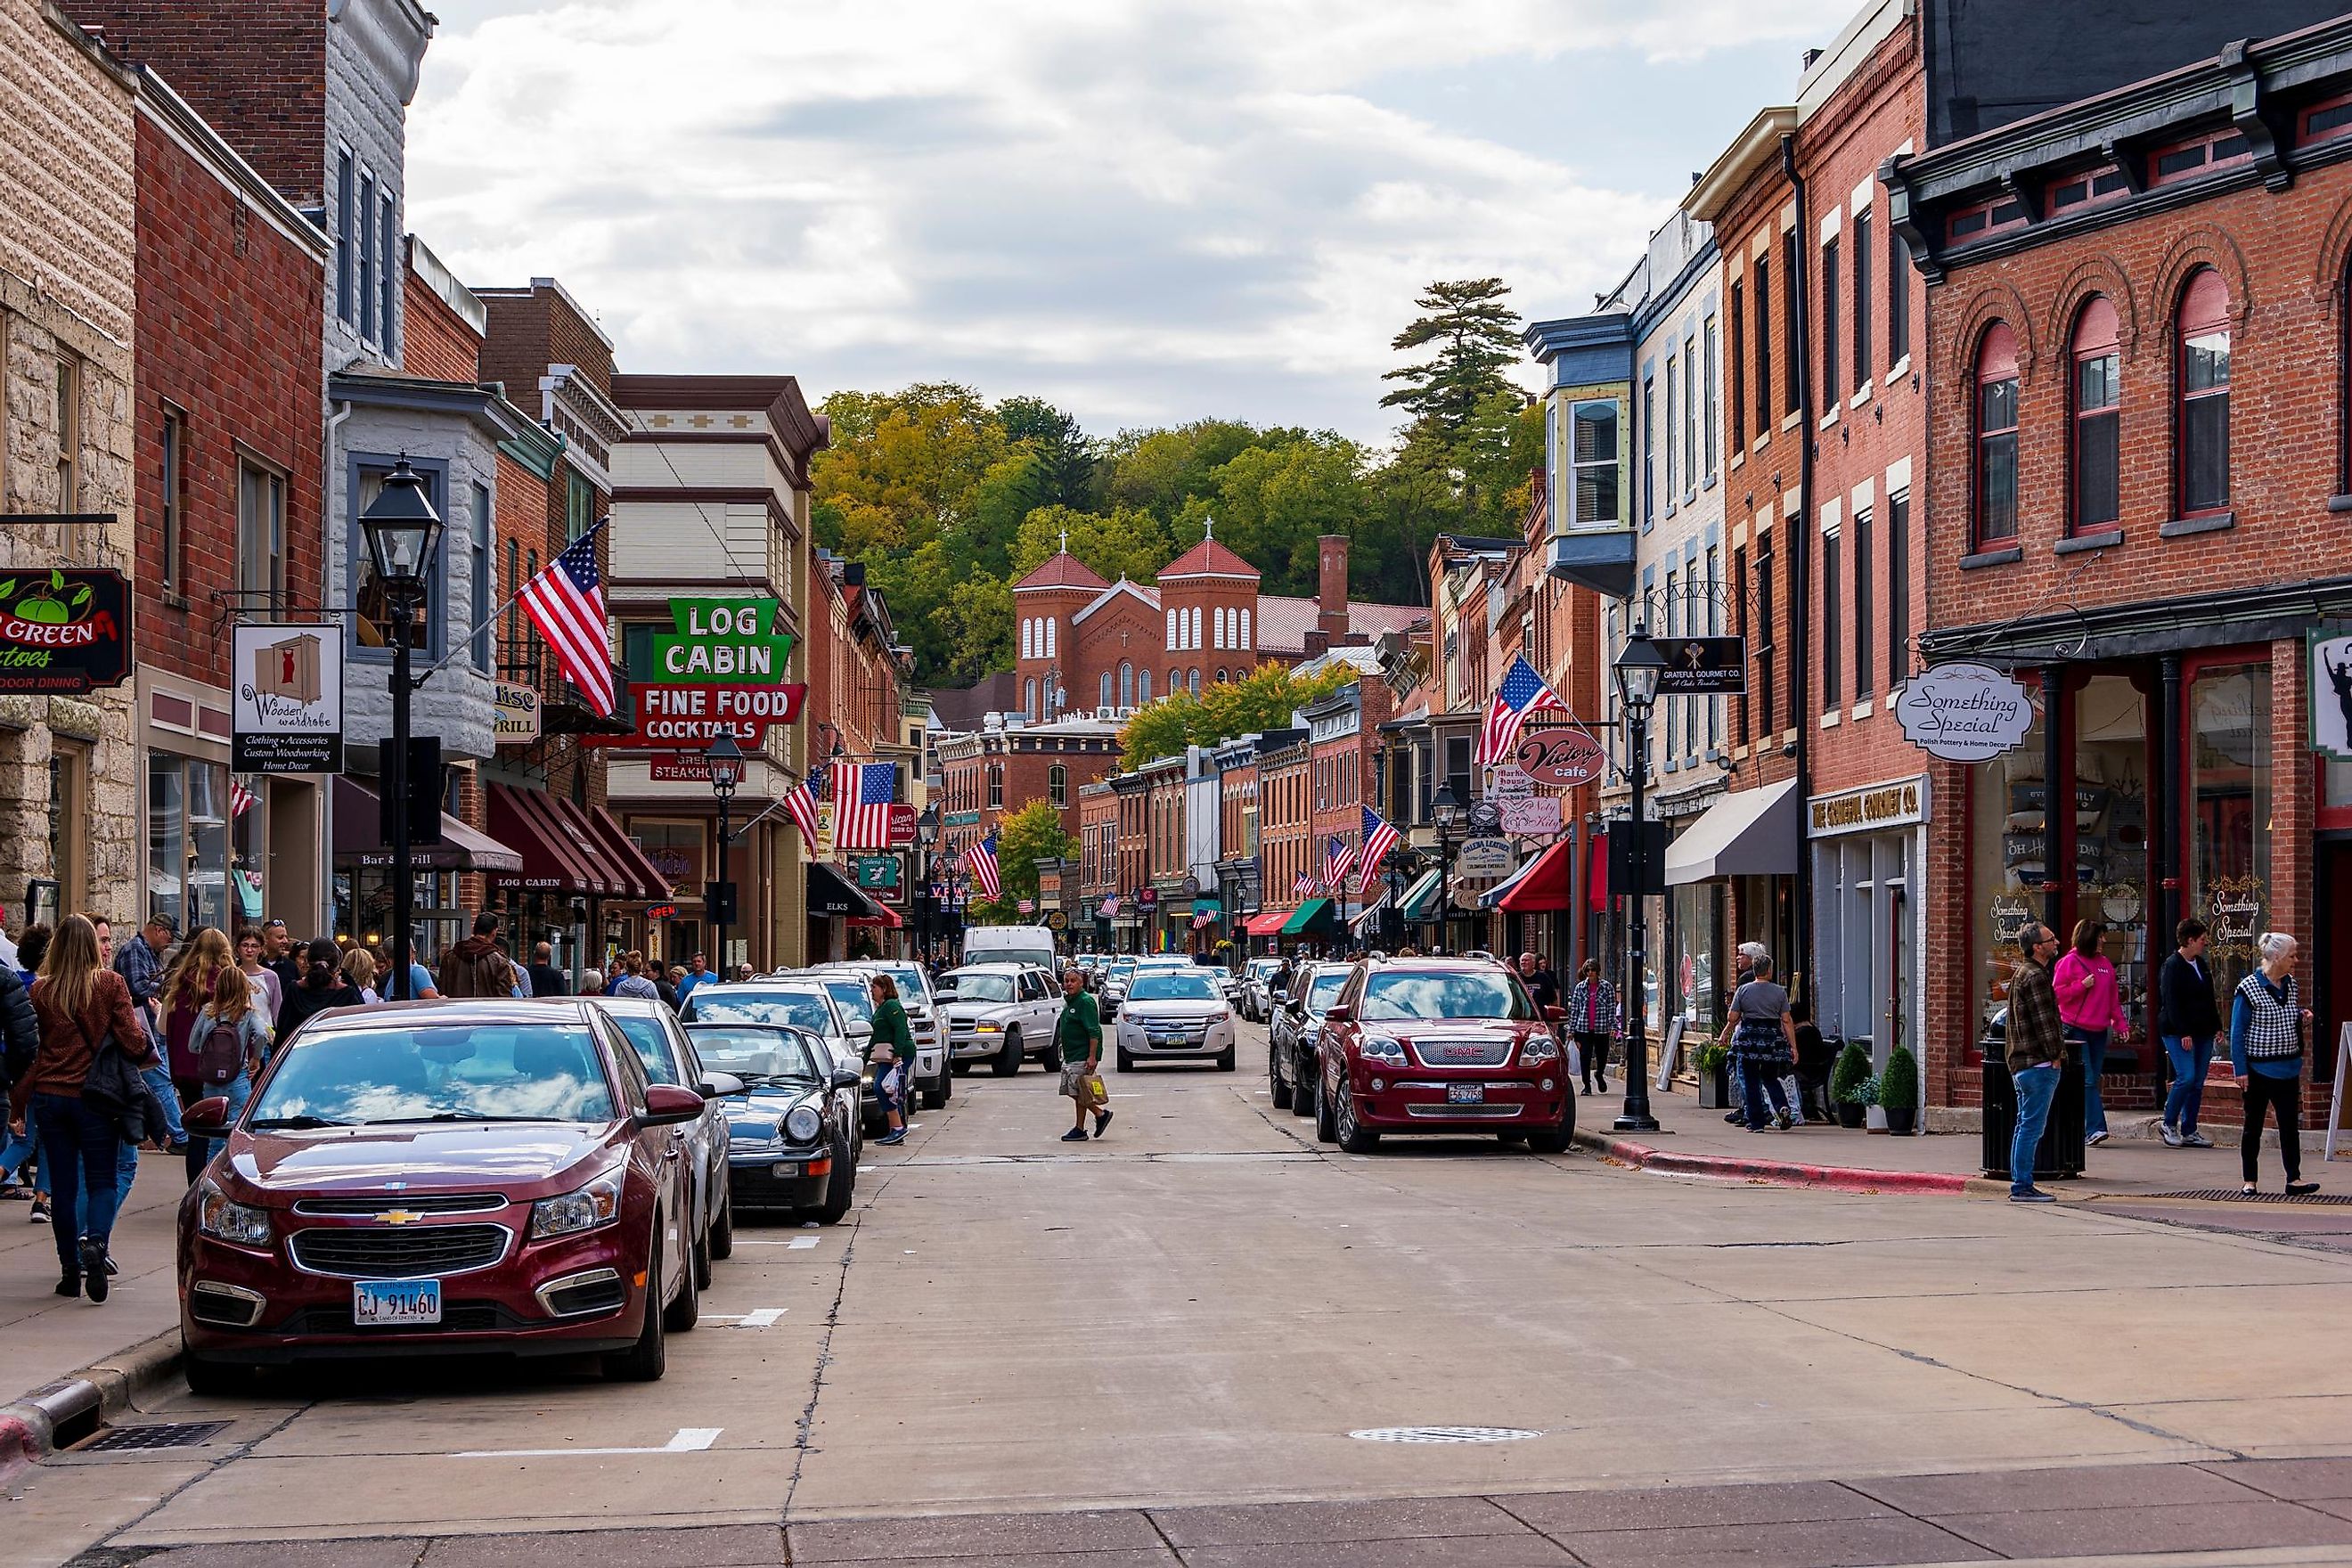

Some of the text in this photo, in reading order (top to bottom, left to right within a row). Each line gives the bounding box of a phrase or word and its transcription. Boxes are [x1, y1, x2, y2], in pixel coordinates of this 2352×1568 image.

[690, 607, 757, 635] LOG
[5, 620, 93, 643] GREEN
[666, 646, 771, 674] CABIN
[1663, 669, 1741, 679] GRATEFUL GOURMET CO.
[37, 678, 81, 688] DINING
[241, 683, 302, 726] Wooden
[646, 690, 788, 716] FINE FOOD
[1907, 685, 2018, 722] Something
[279, 712, 331, 727] wardrobe
[1917, 708, 2003, 739] Special
[246, 736, 328, 747] Clothing Accessories
[1940, 739, 1964, 747] Pottery
[244, 748, 331, 761] Custom Woodworking
[677, 756, 710, 766] GREE
[1518, 739, 1603, 773] Victory
[263, 761, 311, 770] Home Decor
[1555, 766, 1588, 777] cafe
[891, 813, 914, 824] rican
[362, 854, 384, 864] Bar
[411, 853, 430, 864] rill
[498, 878, 560, 886] LOG CABIN
[827, 902, 848, 911] ELKS
[1990, 894, 2029, 920] Something
[2212, 891, 2259, 916] Something
[648, 904, 675, 919] OPEN
[2217, 915, 2254, 943] Special
[1443, 1047, 1483, 1057] GMC
[358, 1293, 437, 1315] CJ 91460
